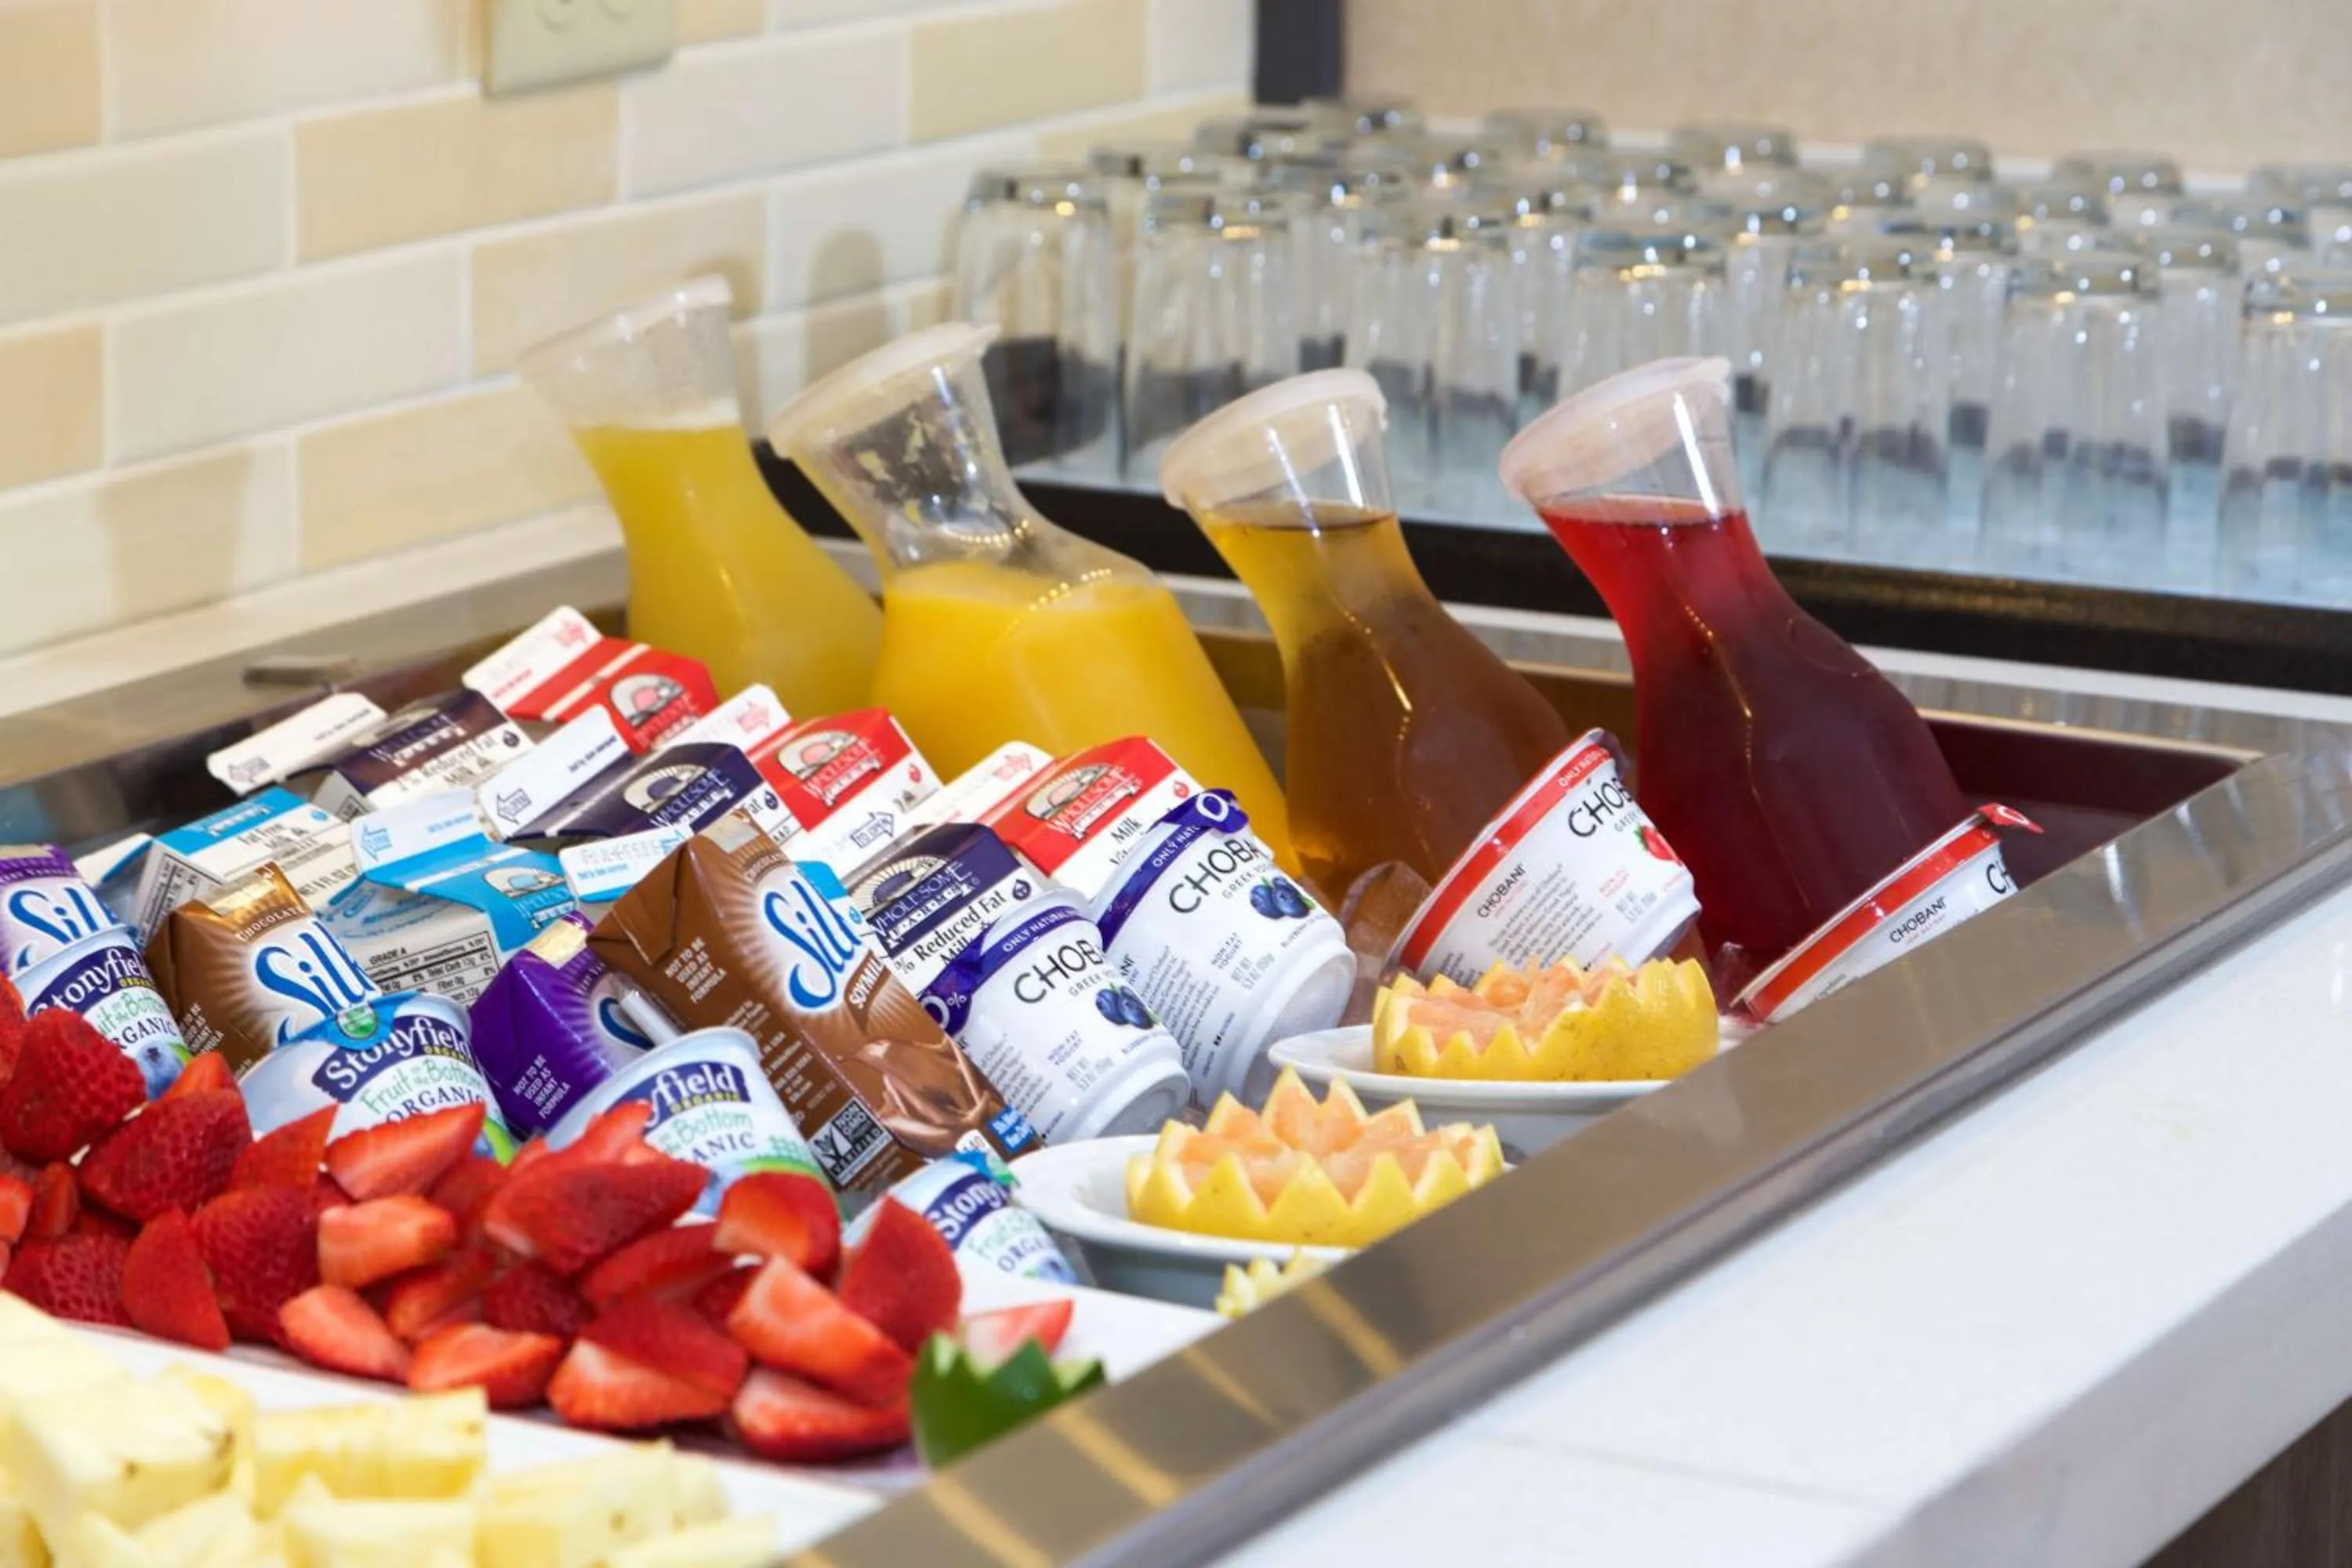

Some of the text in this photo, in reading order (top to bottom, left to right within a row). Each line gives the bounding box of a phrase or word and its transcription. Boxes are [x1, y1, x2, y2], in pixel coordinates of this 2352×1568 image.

[1557, 764, 1582, 788] ONLY
[750, 796, 764, 815] at
[1110, 815, 1144, 844] Milk
[1152, 839, 1178, 869] ONLY
[1176, 825, 1200, 846] NATU
[871, 860, 974, 938] WHOLESOME
[1221, 869, 1256, 900] GREEK
[1477, 864, 1526, 919] CHOBANI
[913, 907, 980, 962] Reduced
[981, 888, 1007, 913] Fat
[1889, 895, 1949, 944] CHOBANI
[368, 949, 399, 966] GRADE
[1003, 928, 1031, 953] ONLY
[662, 957, 684, 978] NOT
[678, 947, 695, 964] TO
[673, 960, 700, 984] USED
[34, 948, 145, 1015] tonyfiel
[687, 965, 731, 1005] FORMULA
[114, 1017, 178, 1051] GANIC
[359, 1070, 410, 1114] Fruit
[510, 1053, 547, 1097] NOT TO BE
[522, 1066, 553, 1101] USED AS
[531, 1076, 561, 1107] INFANT
[535, 1079, 575, 1120] FORMULA
[644, 1063, 738, 1128] yfield
[833, 1102, 862, 1129] NON
[840, 1109, 868, 1138] GMO
[691, 1131, 757, 1164] ANIC
[831, 1126, 883, 1174] VERIFIED
